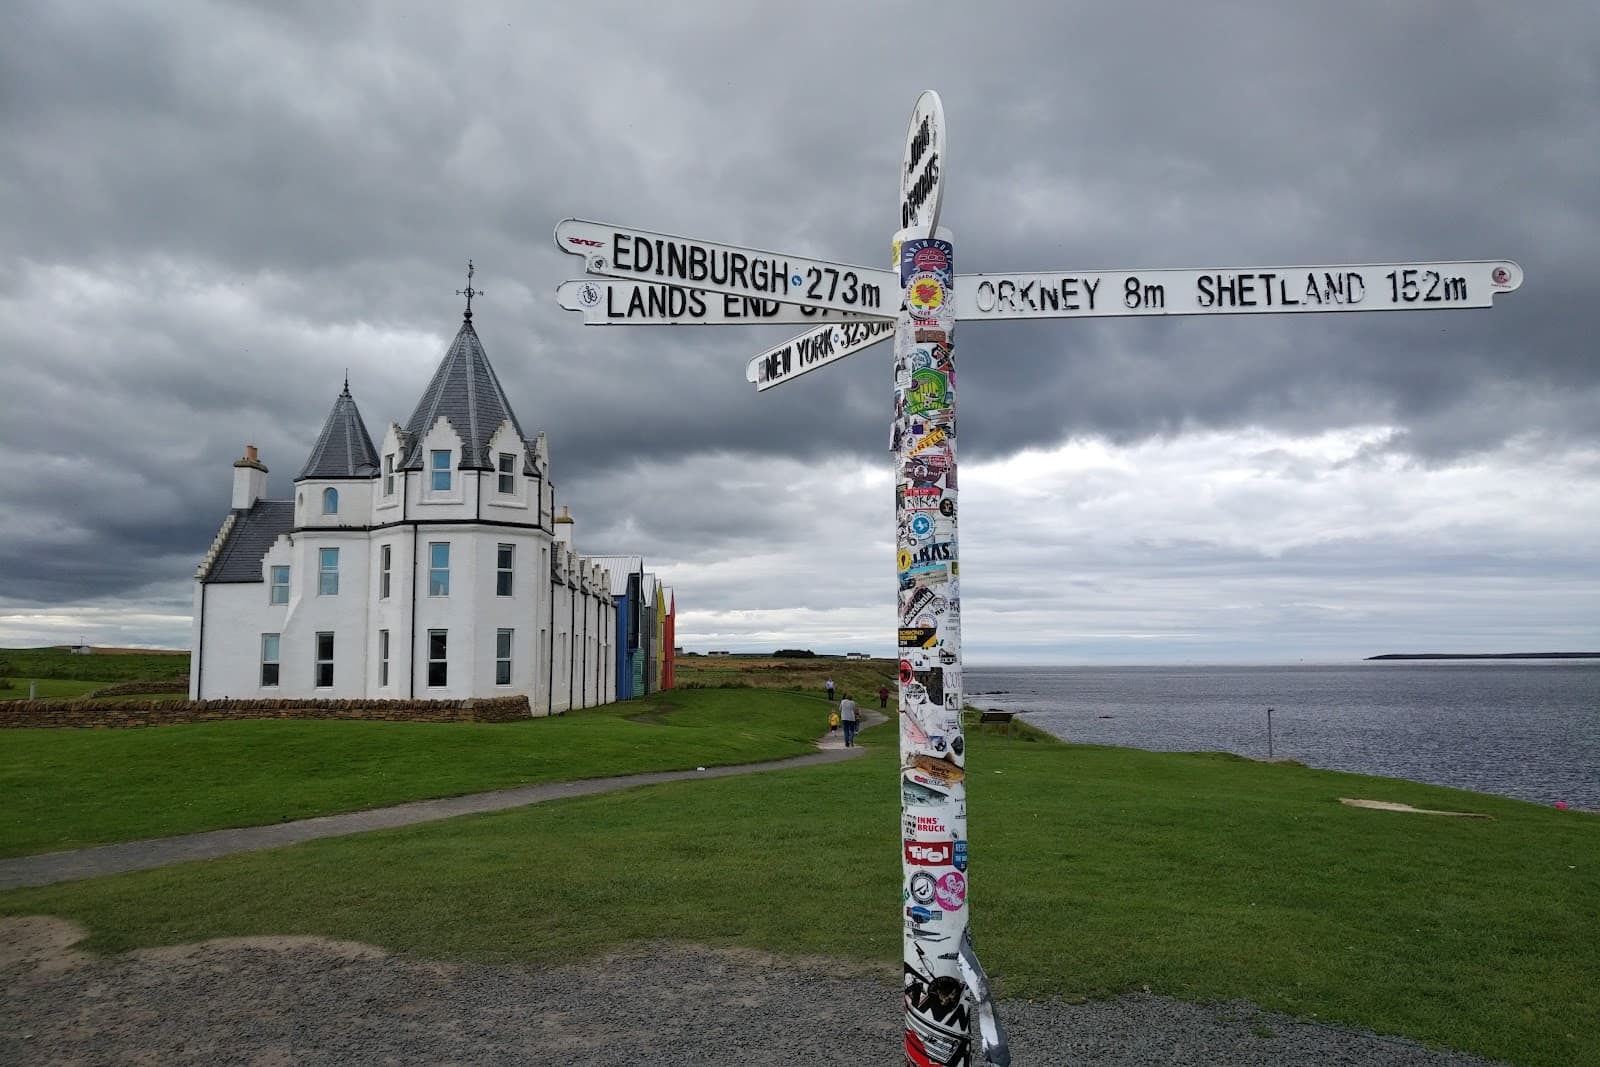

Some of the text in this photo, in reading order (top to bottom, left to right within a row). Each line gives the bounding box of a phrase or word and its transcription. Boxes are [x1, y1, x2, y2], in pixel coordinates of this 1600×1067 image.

[903, 240, 929, 263] NORTH
[612, 233, 789, 295] EDINBURGH
[806, 266, 881, 308] 273m
[607, 285, 707, 318] LANDS
[723, 292, 780, 318] END
[976, 269, 1468, 312] ORKNEY 8m SHETLAND 152m
[764, 344, 792, 382] NEW
[796, 325, 835, 368] YORK
[917, 816, 937, 825] INNS
[917, 824, 946, 832] BRUCK
[908, 845, 949, 863] Tirol
